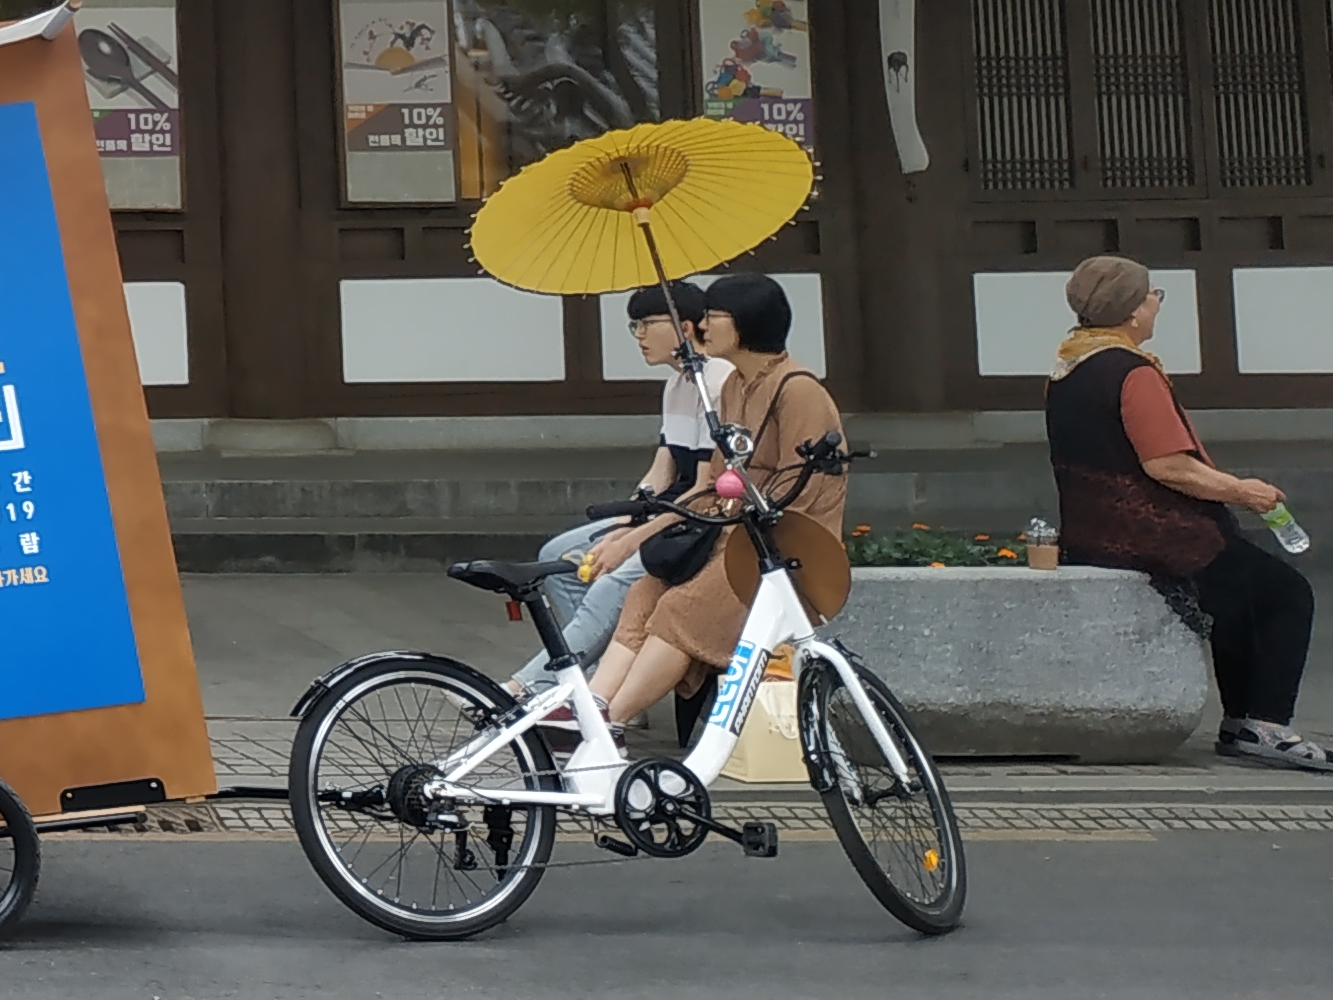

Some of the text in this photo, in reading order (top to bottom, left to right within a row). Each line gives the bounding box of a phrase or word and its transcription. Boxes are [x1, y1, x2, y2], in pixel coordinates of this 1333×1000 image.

[400, 107, 444, 125] 10%
[760, 102, 805, 121] 10%
[127, 112, 171, 131] 10%
[129, 133, 172, 152] 할인
[403, 127, 445, 146] 할인
